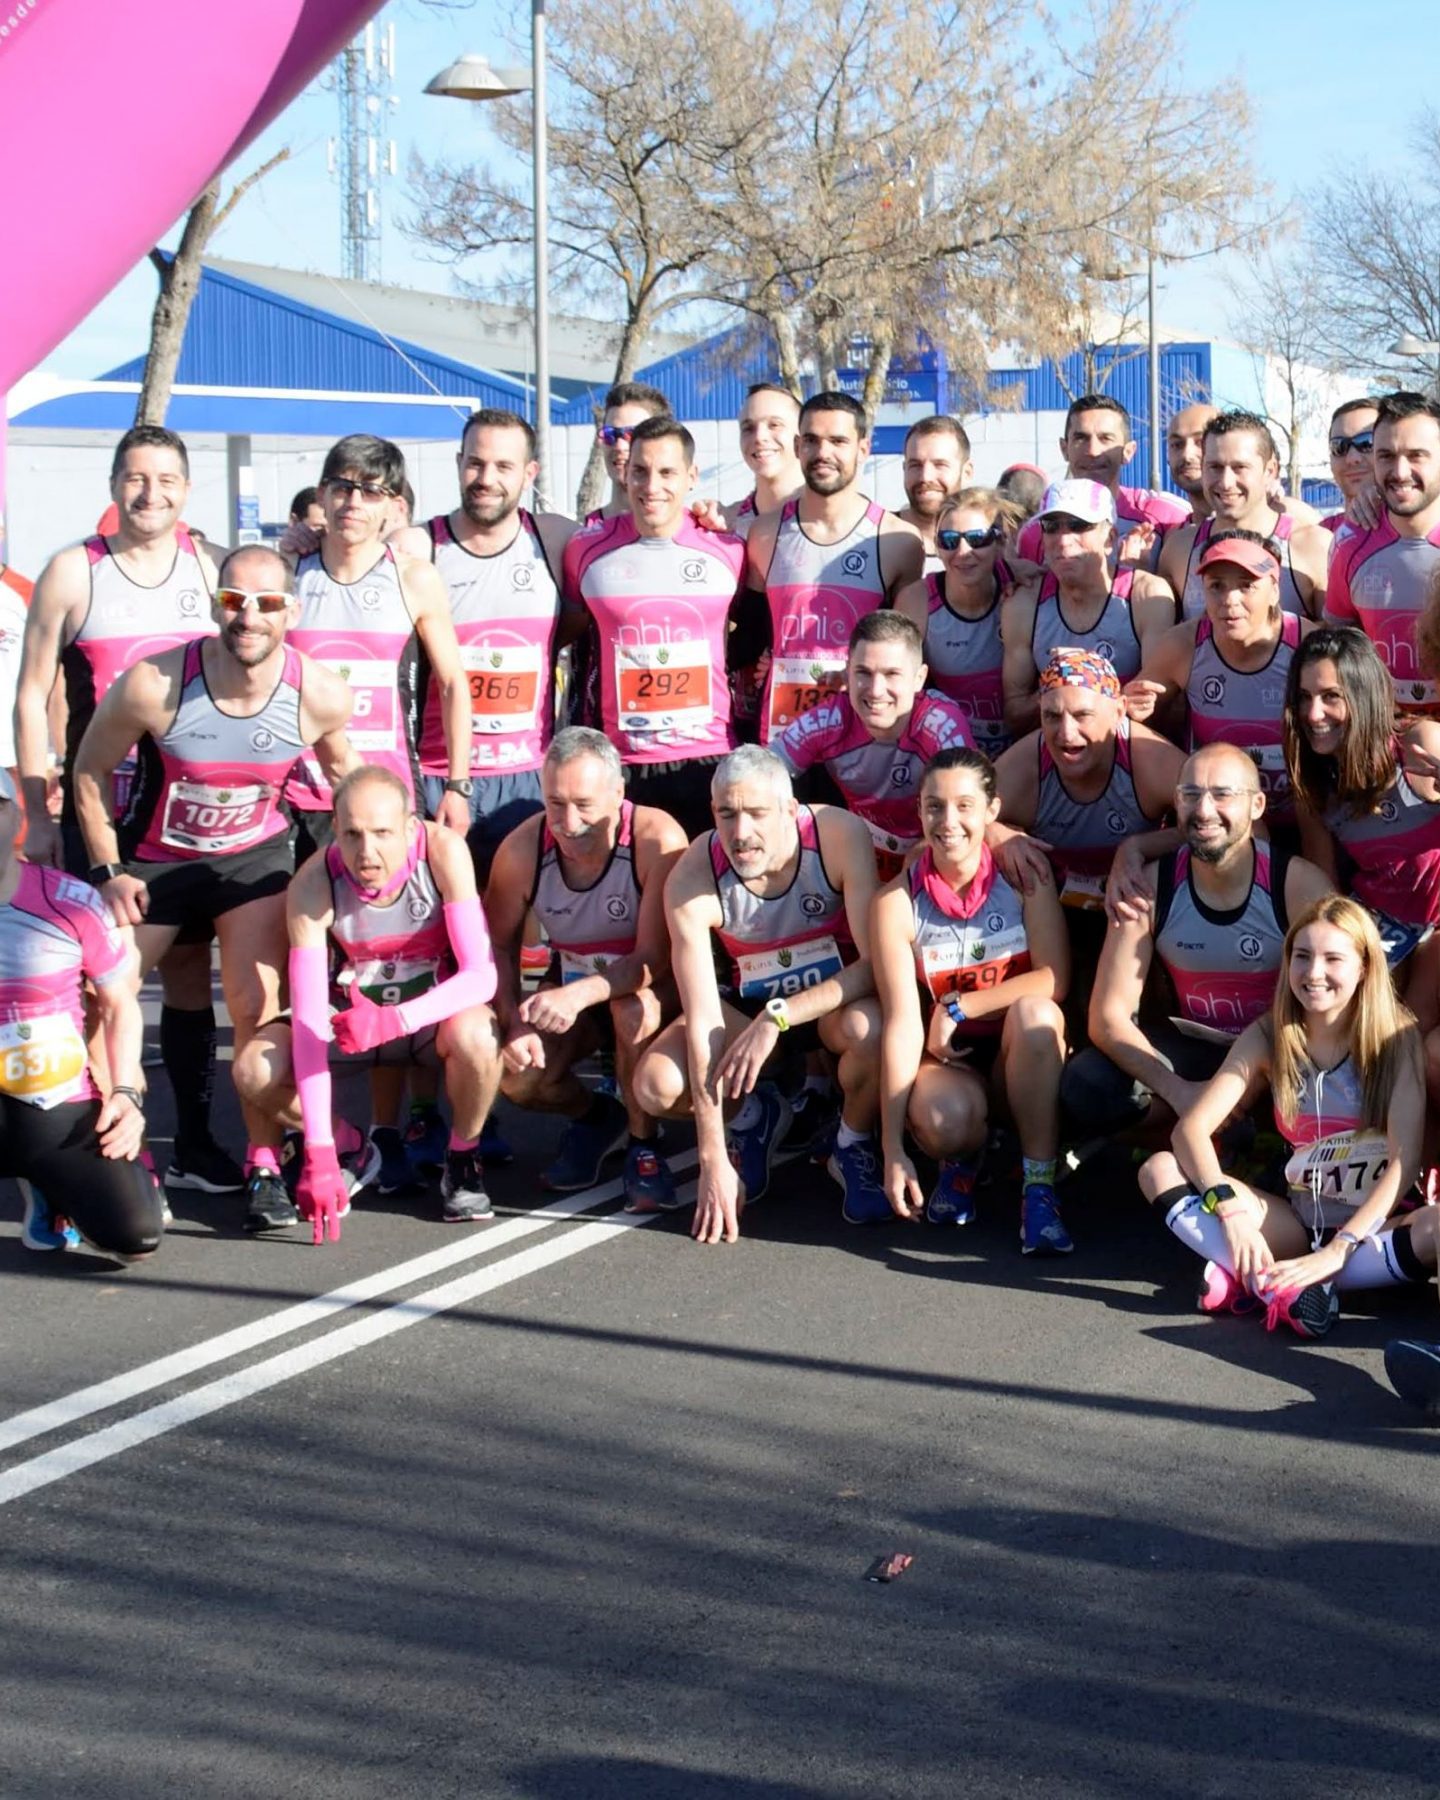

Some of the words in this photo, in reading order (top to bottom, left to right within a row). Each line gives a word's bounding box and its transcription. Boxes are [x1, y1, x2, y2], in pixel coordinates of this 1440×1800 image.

[470, 675, 522, 700] 366
[637, 671, 690, 698] 292
[185, 803, 257, 828] 1072
[764, 966, 822, 1000] 780
